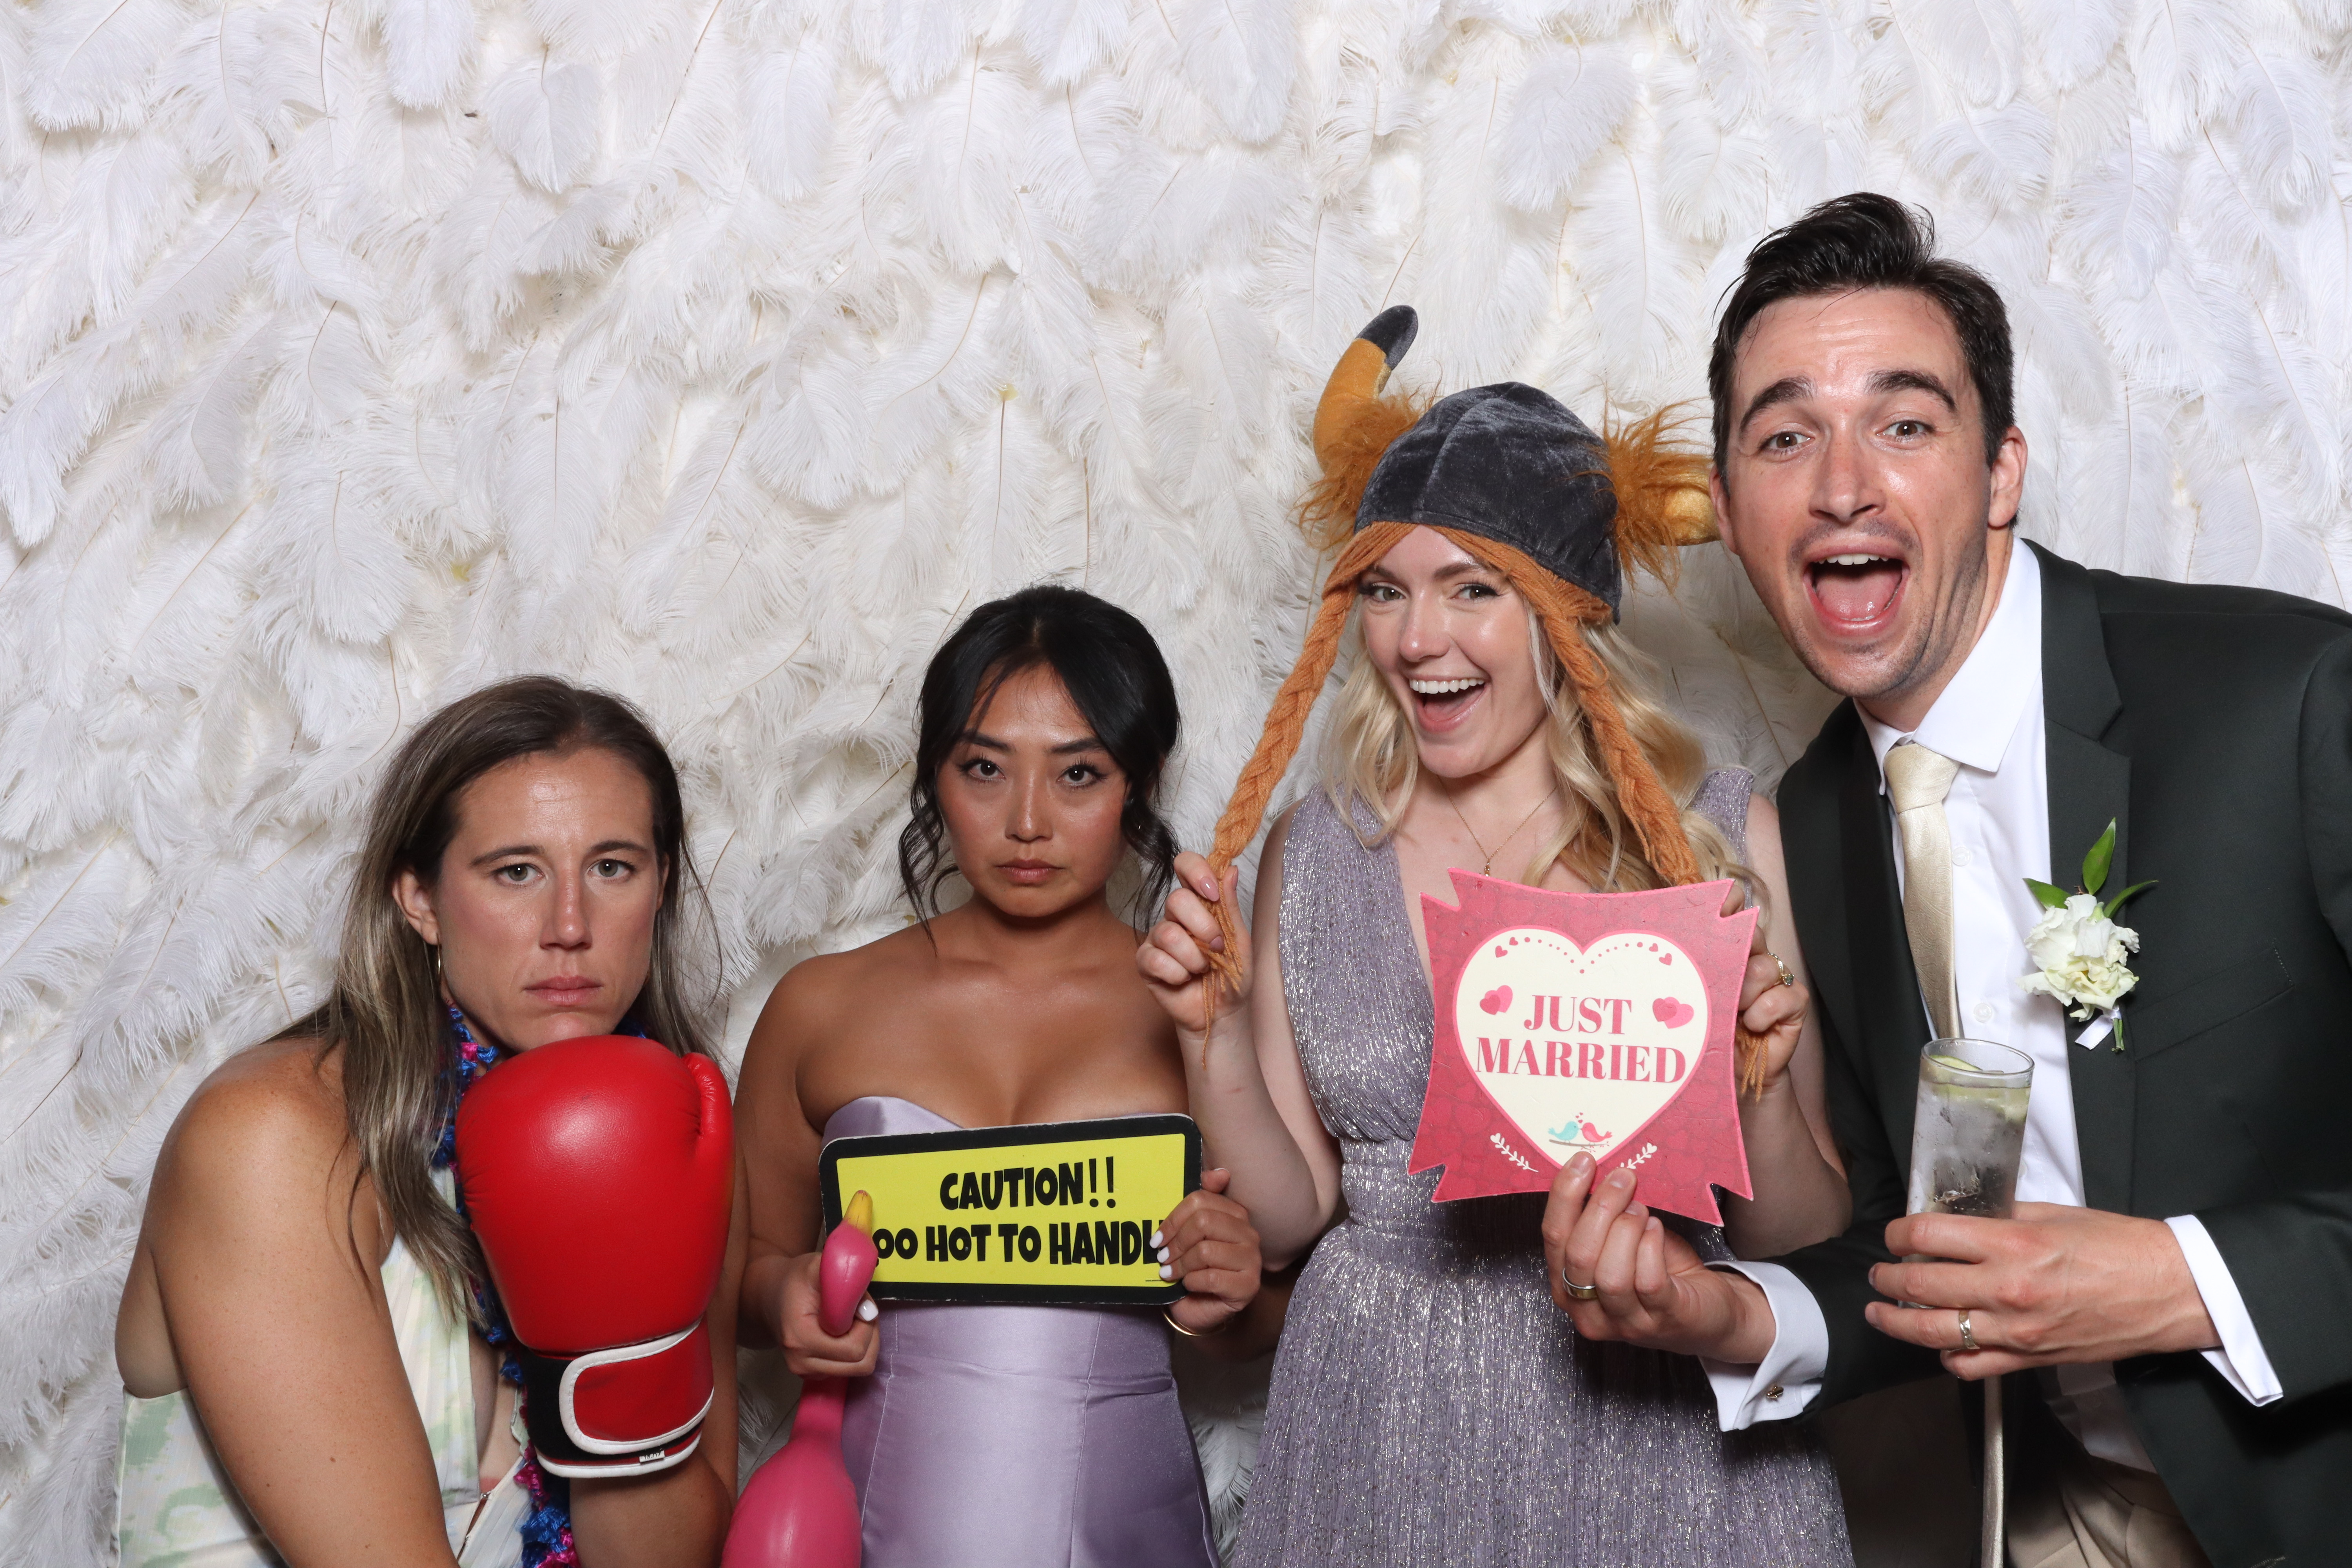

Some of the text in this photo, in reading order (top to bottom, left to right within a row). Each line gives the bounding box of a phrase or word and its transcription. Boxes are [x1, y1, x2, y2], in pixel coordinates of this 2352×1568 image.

[1524, 995, 1632, 1034] JUST
[1475, 1037, 1686, 1083] MARRIED
[940, 1156, 1116, 1210] CAUTION!!
[872, 1220, 1166, 1267] OO HOT TO HANDL
